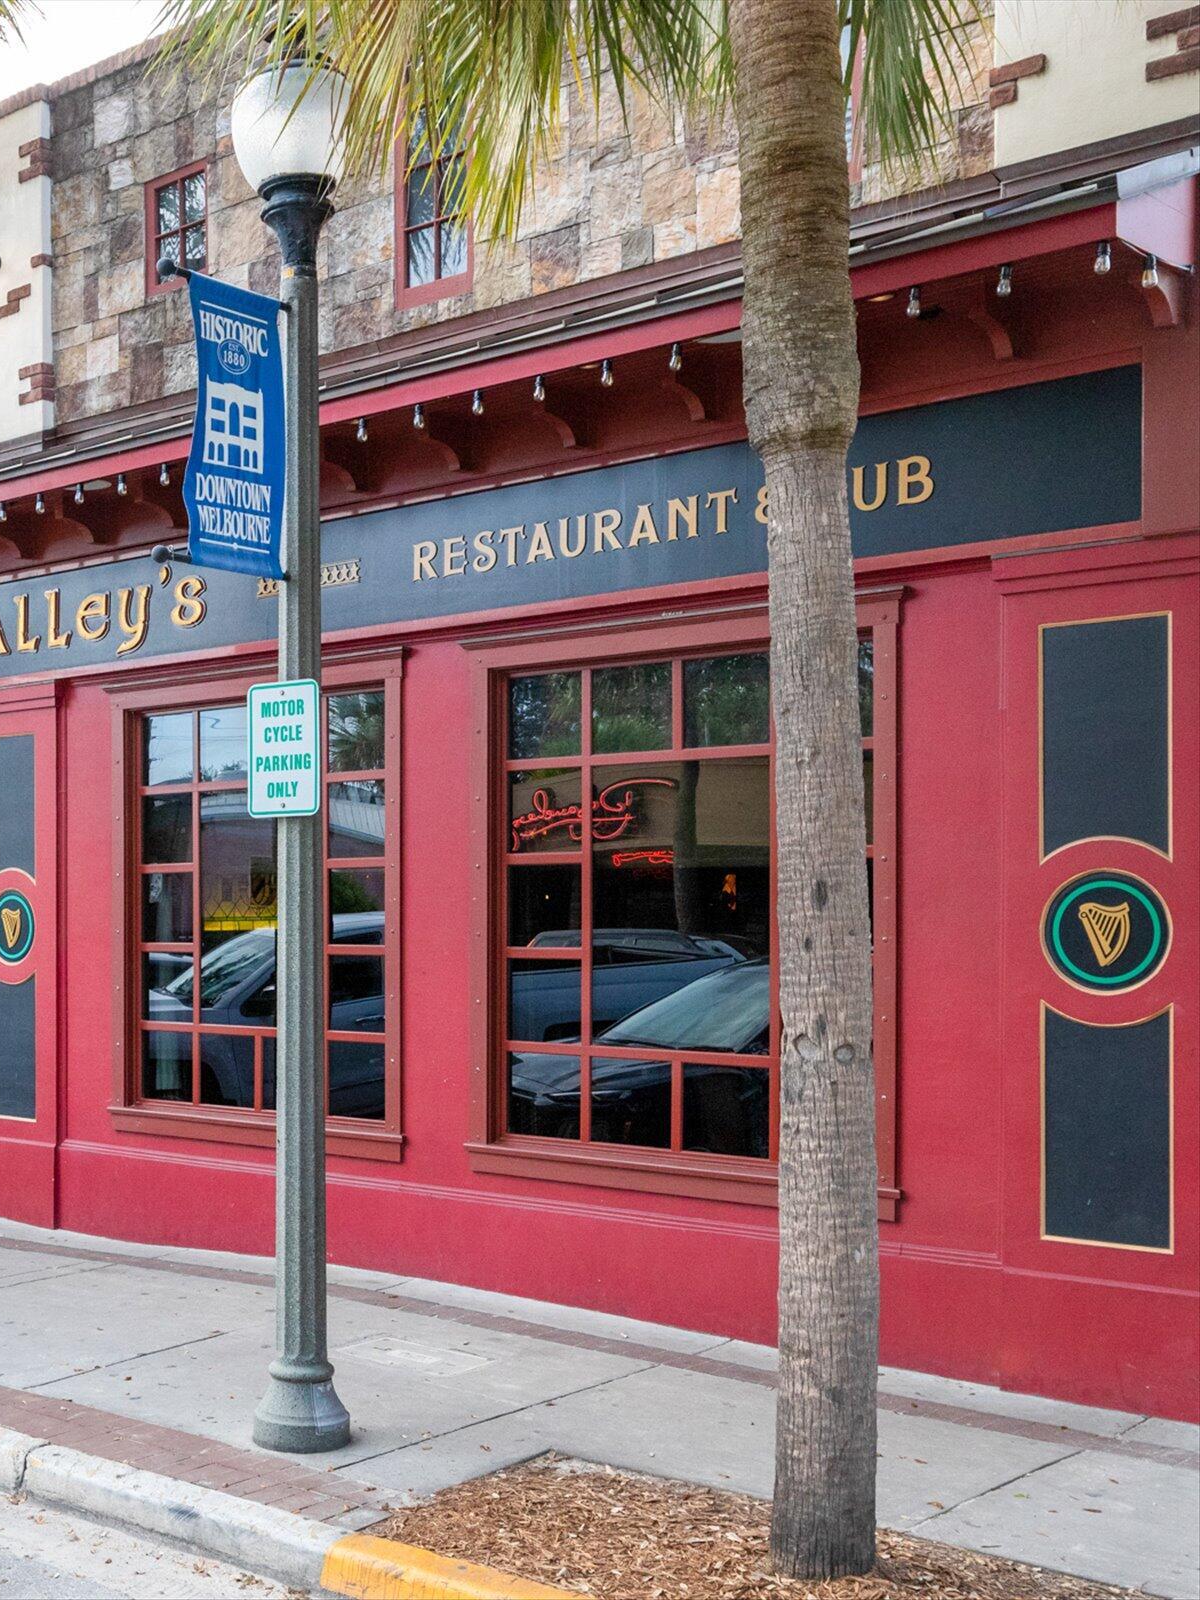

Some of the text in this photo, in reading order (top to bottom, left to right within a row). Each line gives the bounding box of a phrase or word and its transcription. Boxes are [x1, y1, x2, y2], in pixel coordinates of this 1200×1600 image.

[199, 310, 269, 357] HISTORIC
[223, 350, 246, 367] 1880
[195, 472, 271, 513] DOWNTOWN
[197, 504, 271, 544] MELBOURNE
[412, 487, 739, 582] RESTAURANT
[851, 455, 935, 512] UB
[261, 699, 305, 718] MOTOR
[264, 725, 303, 743] CYCLE
[256, 753, 312, 772] PARKING
[267, 781, 299, 799] ONLY
